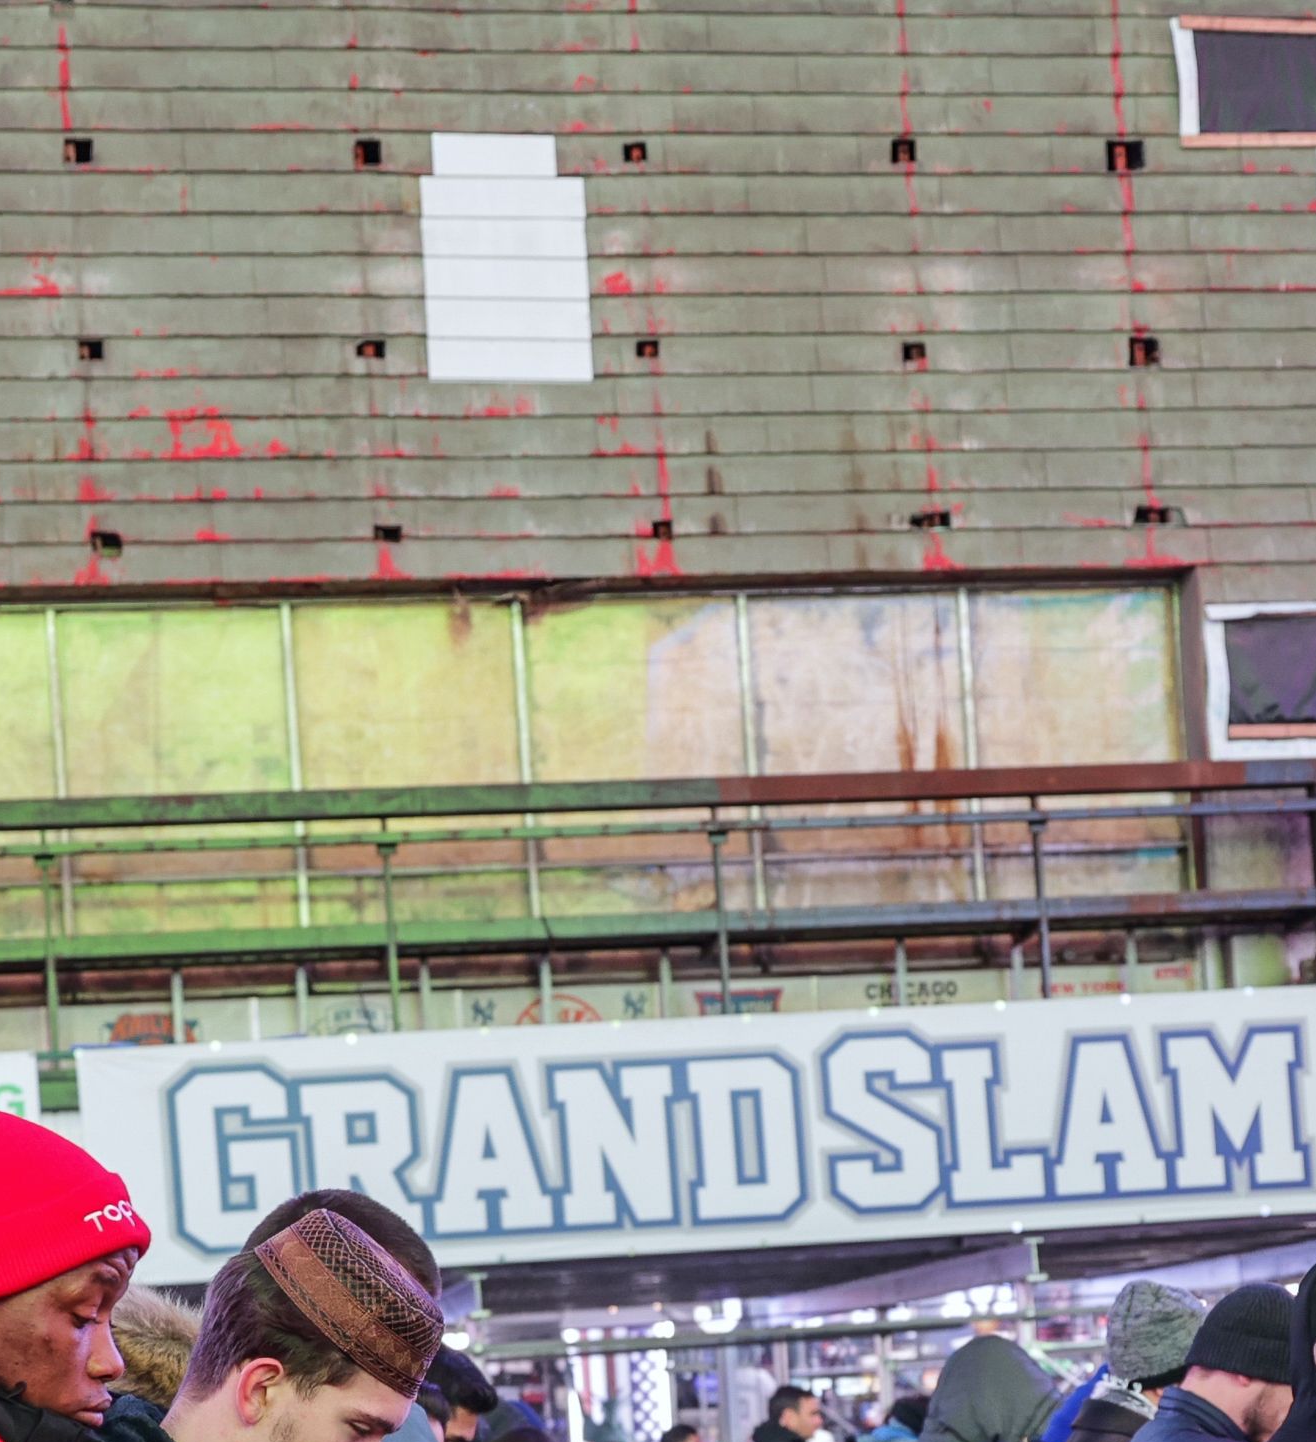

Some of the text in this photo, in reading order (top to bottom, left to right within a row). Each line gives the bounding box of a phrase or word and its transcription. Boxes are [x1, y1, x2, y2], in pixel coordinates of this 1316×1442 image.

[865, 981, 958, 1000] CHCAGO
[166, 1023, 1313, 1254] GRAND SLAM
